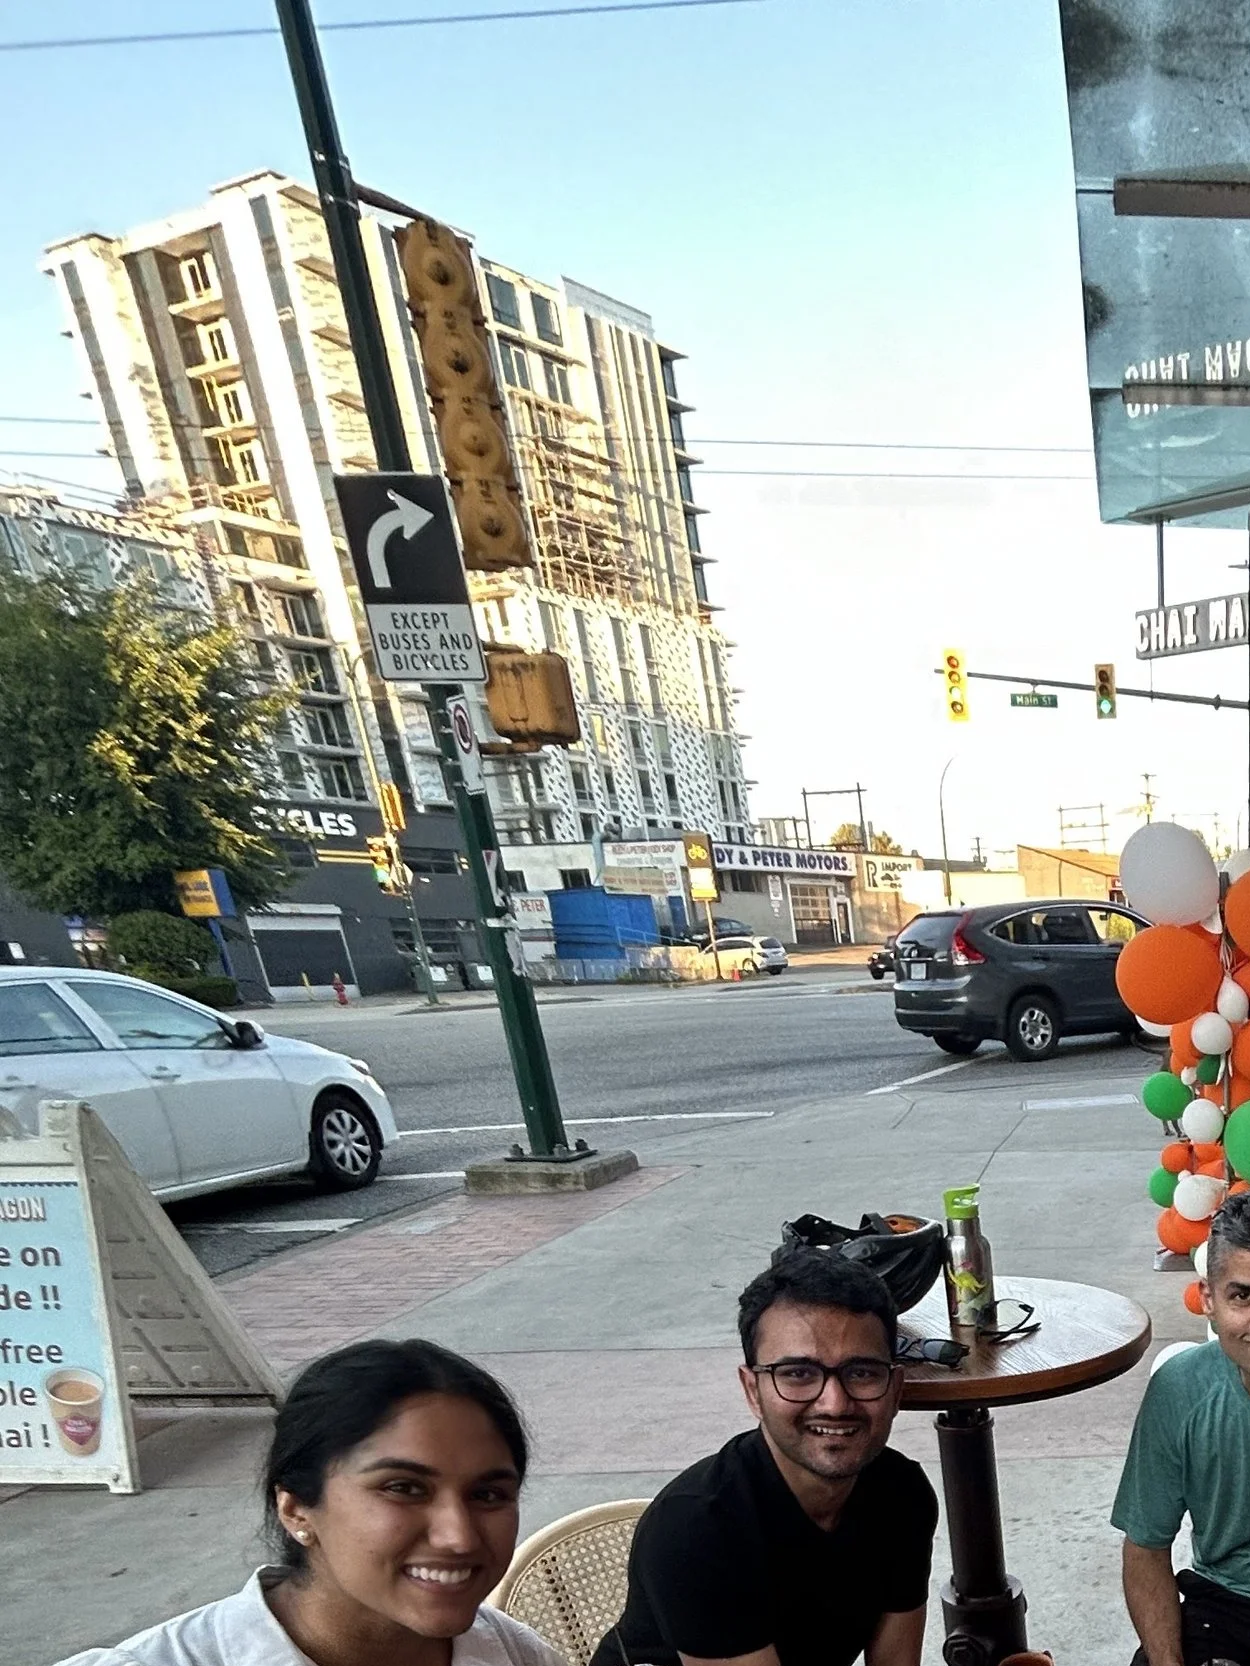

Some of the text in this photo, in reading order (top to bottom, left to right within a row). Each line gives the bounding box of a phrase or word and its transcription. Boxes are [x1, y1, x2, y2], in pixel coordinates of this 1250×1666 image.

[391, 612, 450, 630] EXCEPT
[1136, 605, 1198, 652] CHAI
[378, 633, 473, 650] BUSES AND
[392, 654, 469, 671] BICYCLES
[740, 851, 749, 865] &
[752, 850, 792, 868] PETER
[796, 853, 848, 871] MOTORS
[521, 899, 547, 911] PETER
[20, 1246, 61, 1267] on
[40, 1285, 63, 1311] !!
[1, 1338, 63, 1364] free
[0, 1421, 32, 1448] ai
[41, 1423, 51, 1448] !
